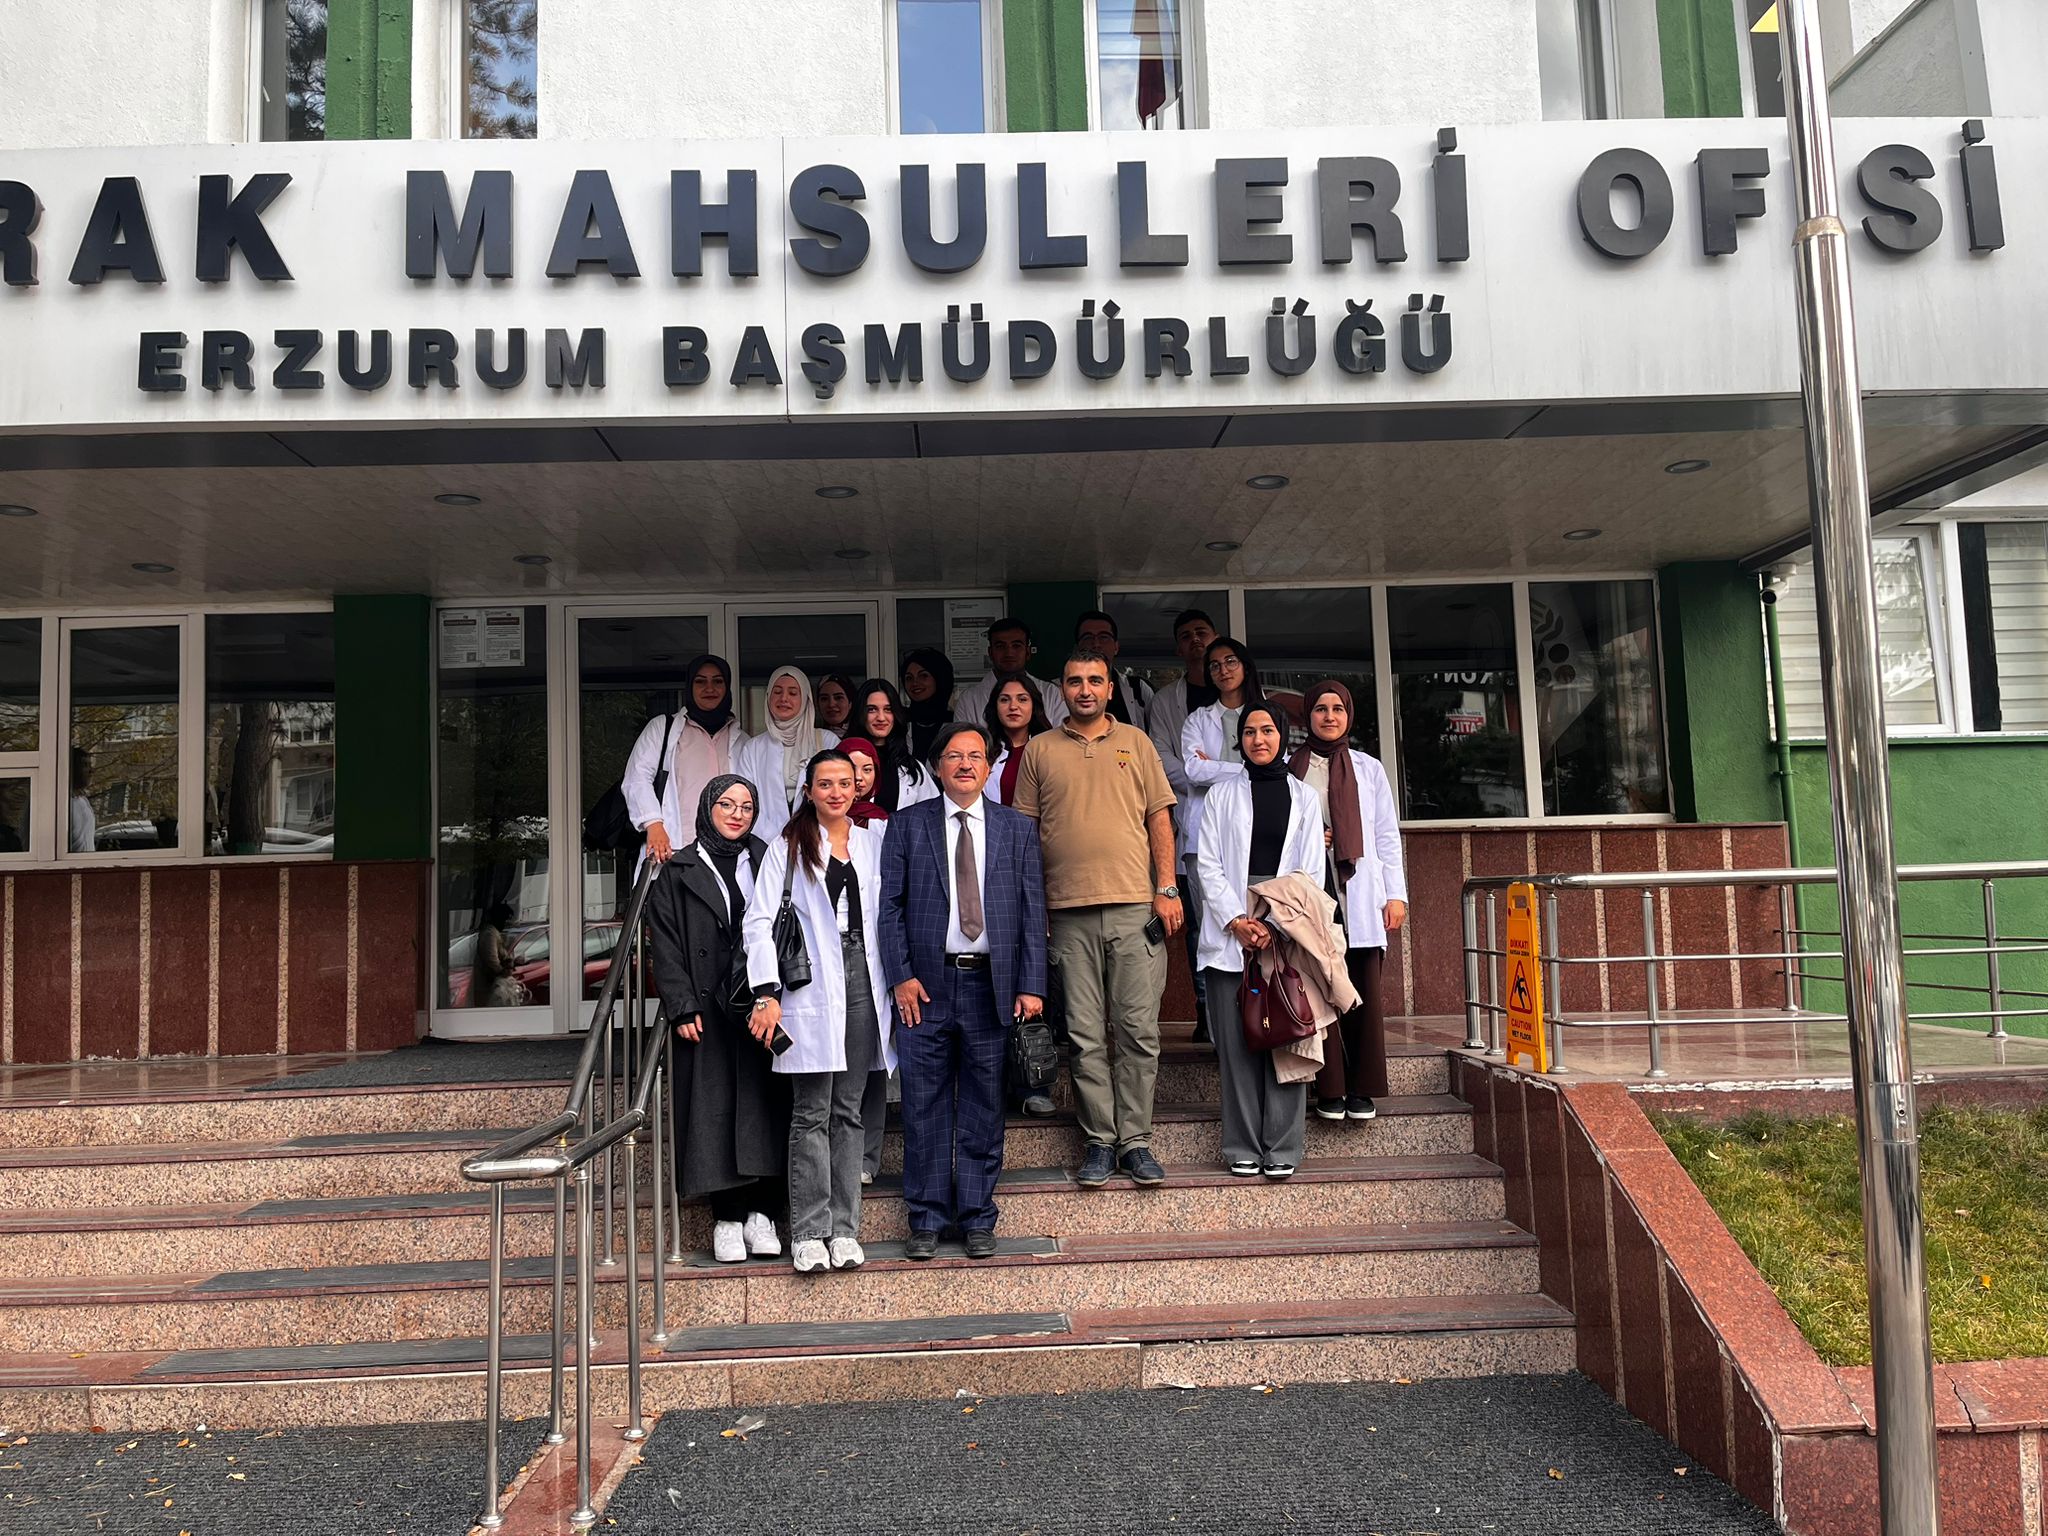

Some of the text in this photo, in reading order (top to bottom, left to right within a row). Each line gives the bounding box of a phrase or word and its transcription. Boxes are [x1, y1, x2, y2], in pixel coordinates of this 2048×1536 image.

[405, 127, 1470, 280] MAHSULLERİ
[1575, 120, 2006, 260] OFSİ
[138, 293, 1452, 399] ERZURUM BAŞMÜDÜRLÜĞÜ
